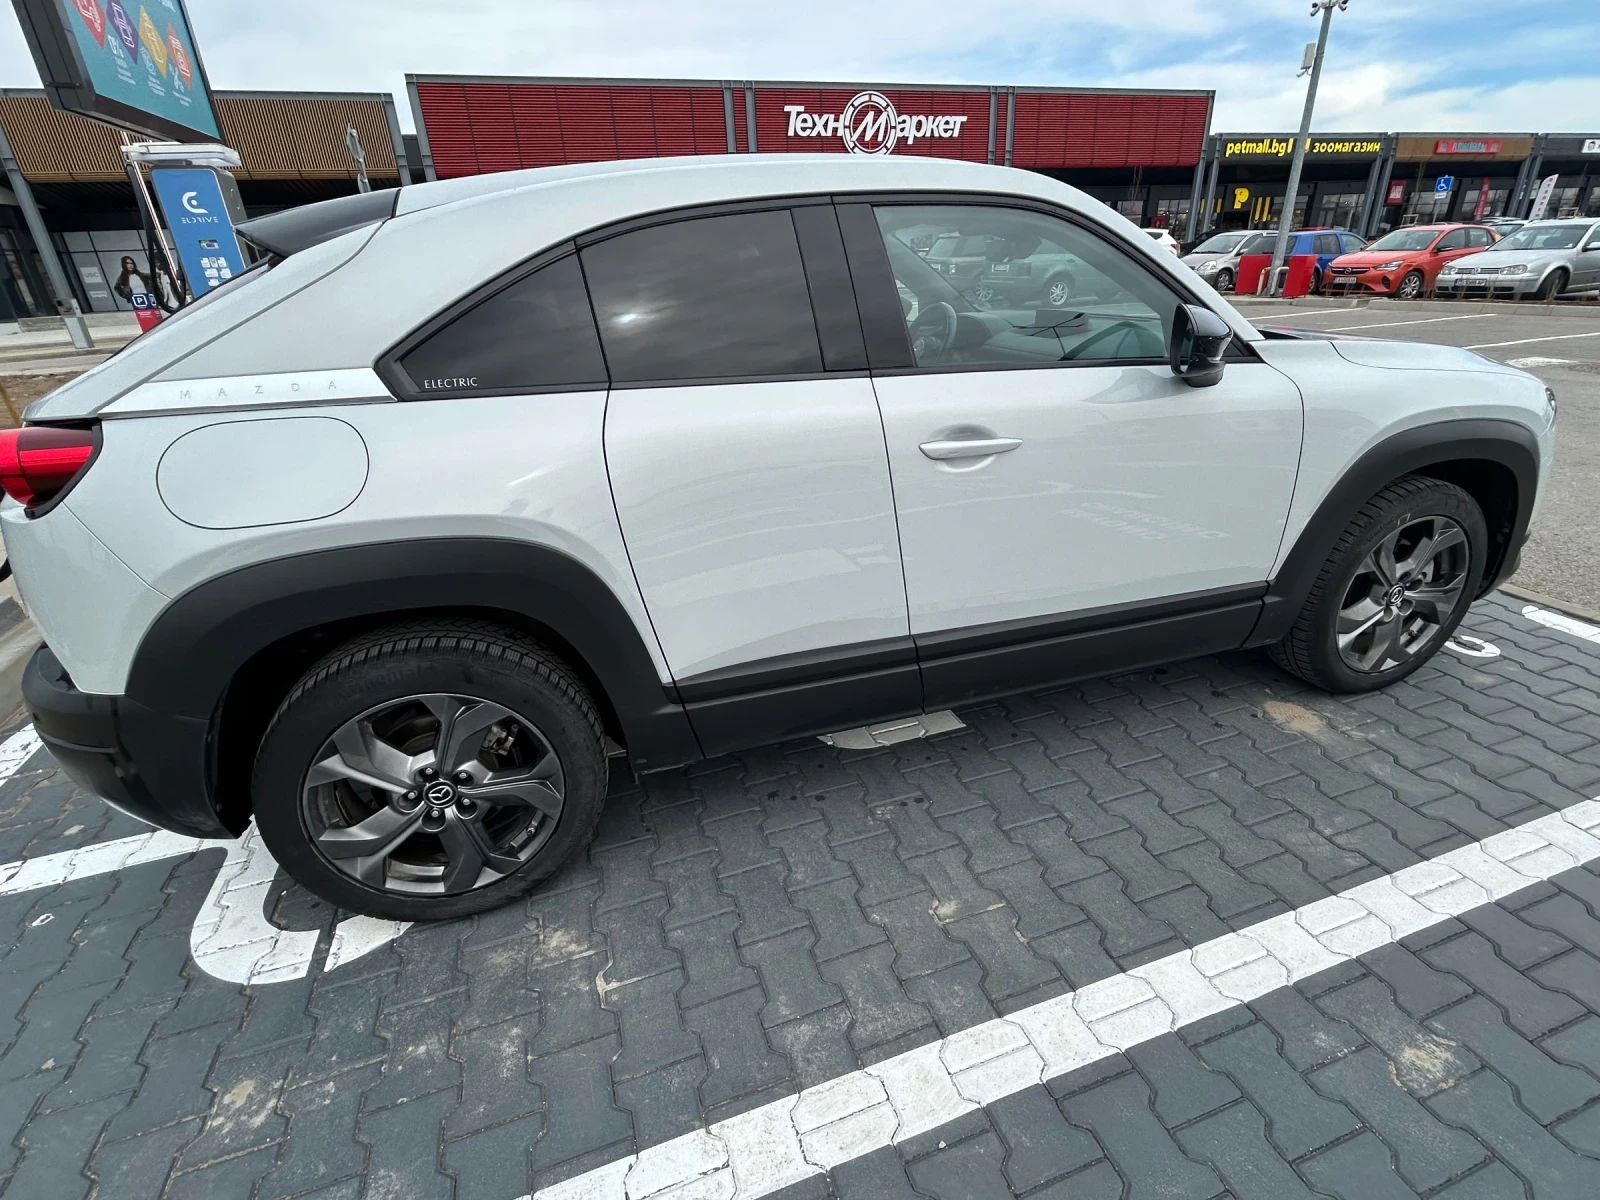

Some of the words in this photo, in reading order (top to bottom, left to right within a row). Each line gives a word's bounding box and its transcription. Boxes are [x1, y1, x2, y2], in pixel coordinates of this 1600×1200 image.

[1226, 138, 1288, 157] petmall.bg
[1313, 141, 1381, 153] зоомагазин
[181, 216, 219, 224] ELDRIVE
[179, 380, 337, 400] MAZDA
[423, 376, 479, 390] ELECTRIC
